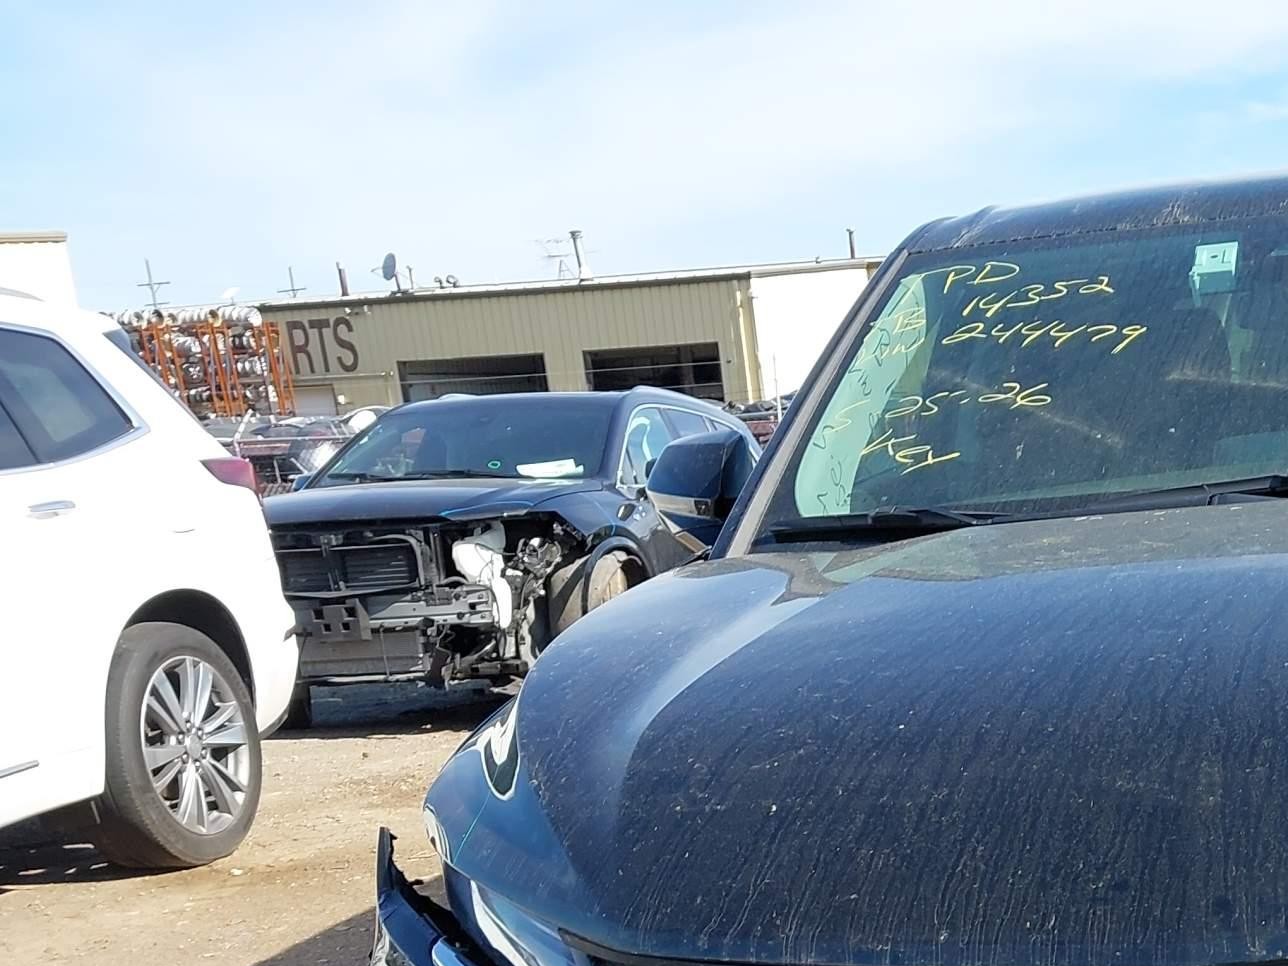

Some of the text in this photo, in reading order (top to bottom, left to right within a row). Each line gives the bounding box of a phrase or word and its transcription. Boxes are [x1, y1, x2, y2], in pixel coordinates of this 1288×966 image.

[962, 276, 1115, 318] 14352
[283, 316, 359, 375] RTS
[941, 323, 1148, 355] 244479
